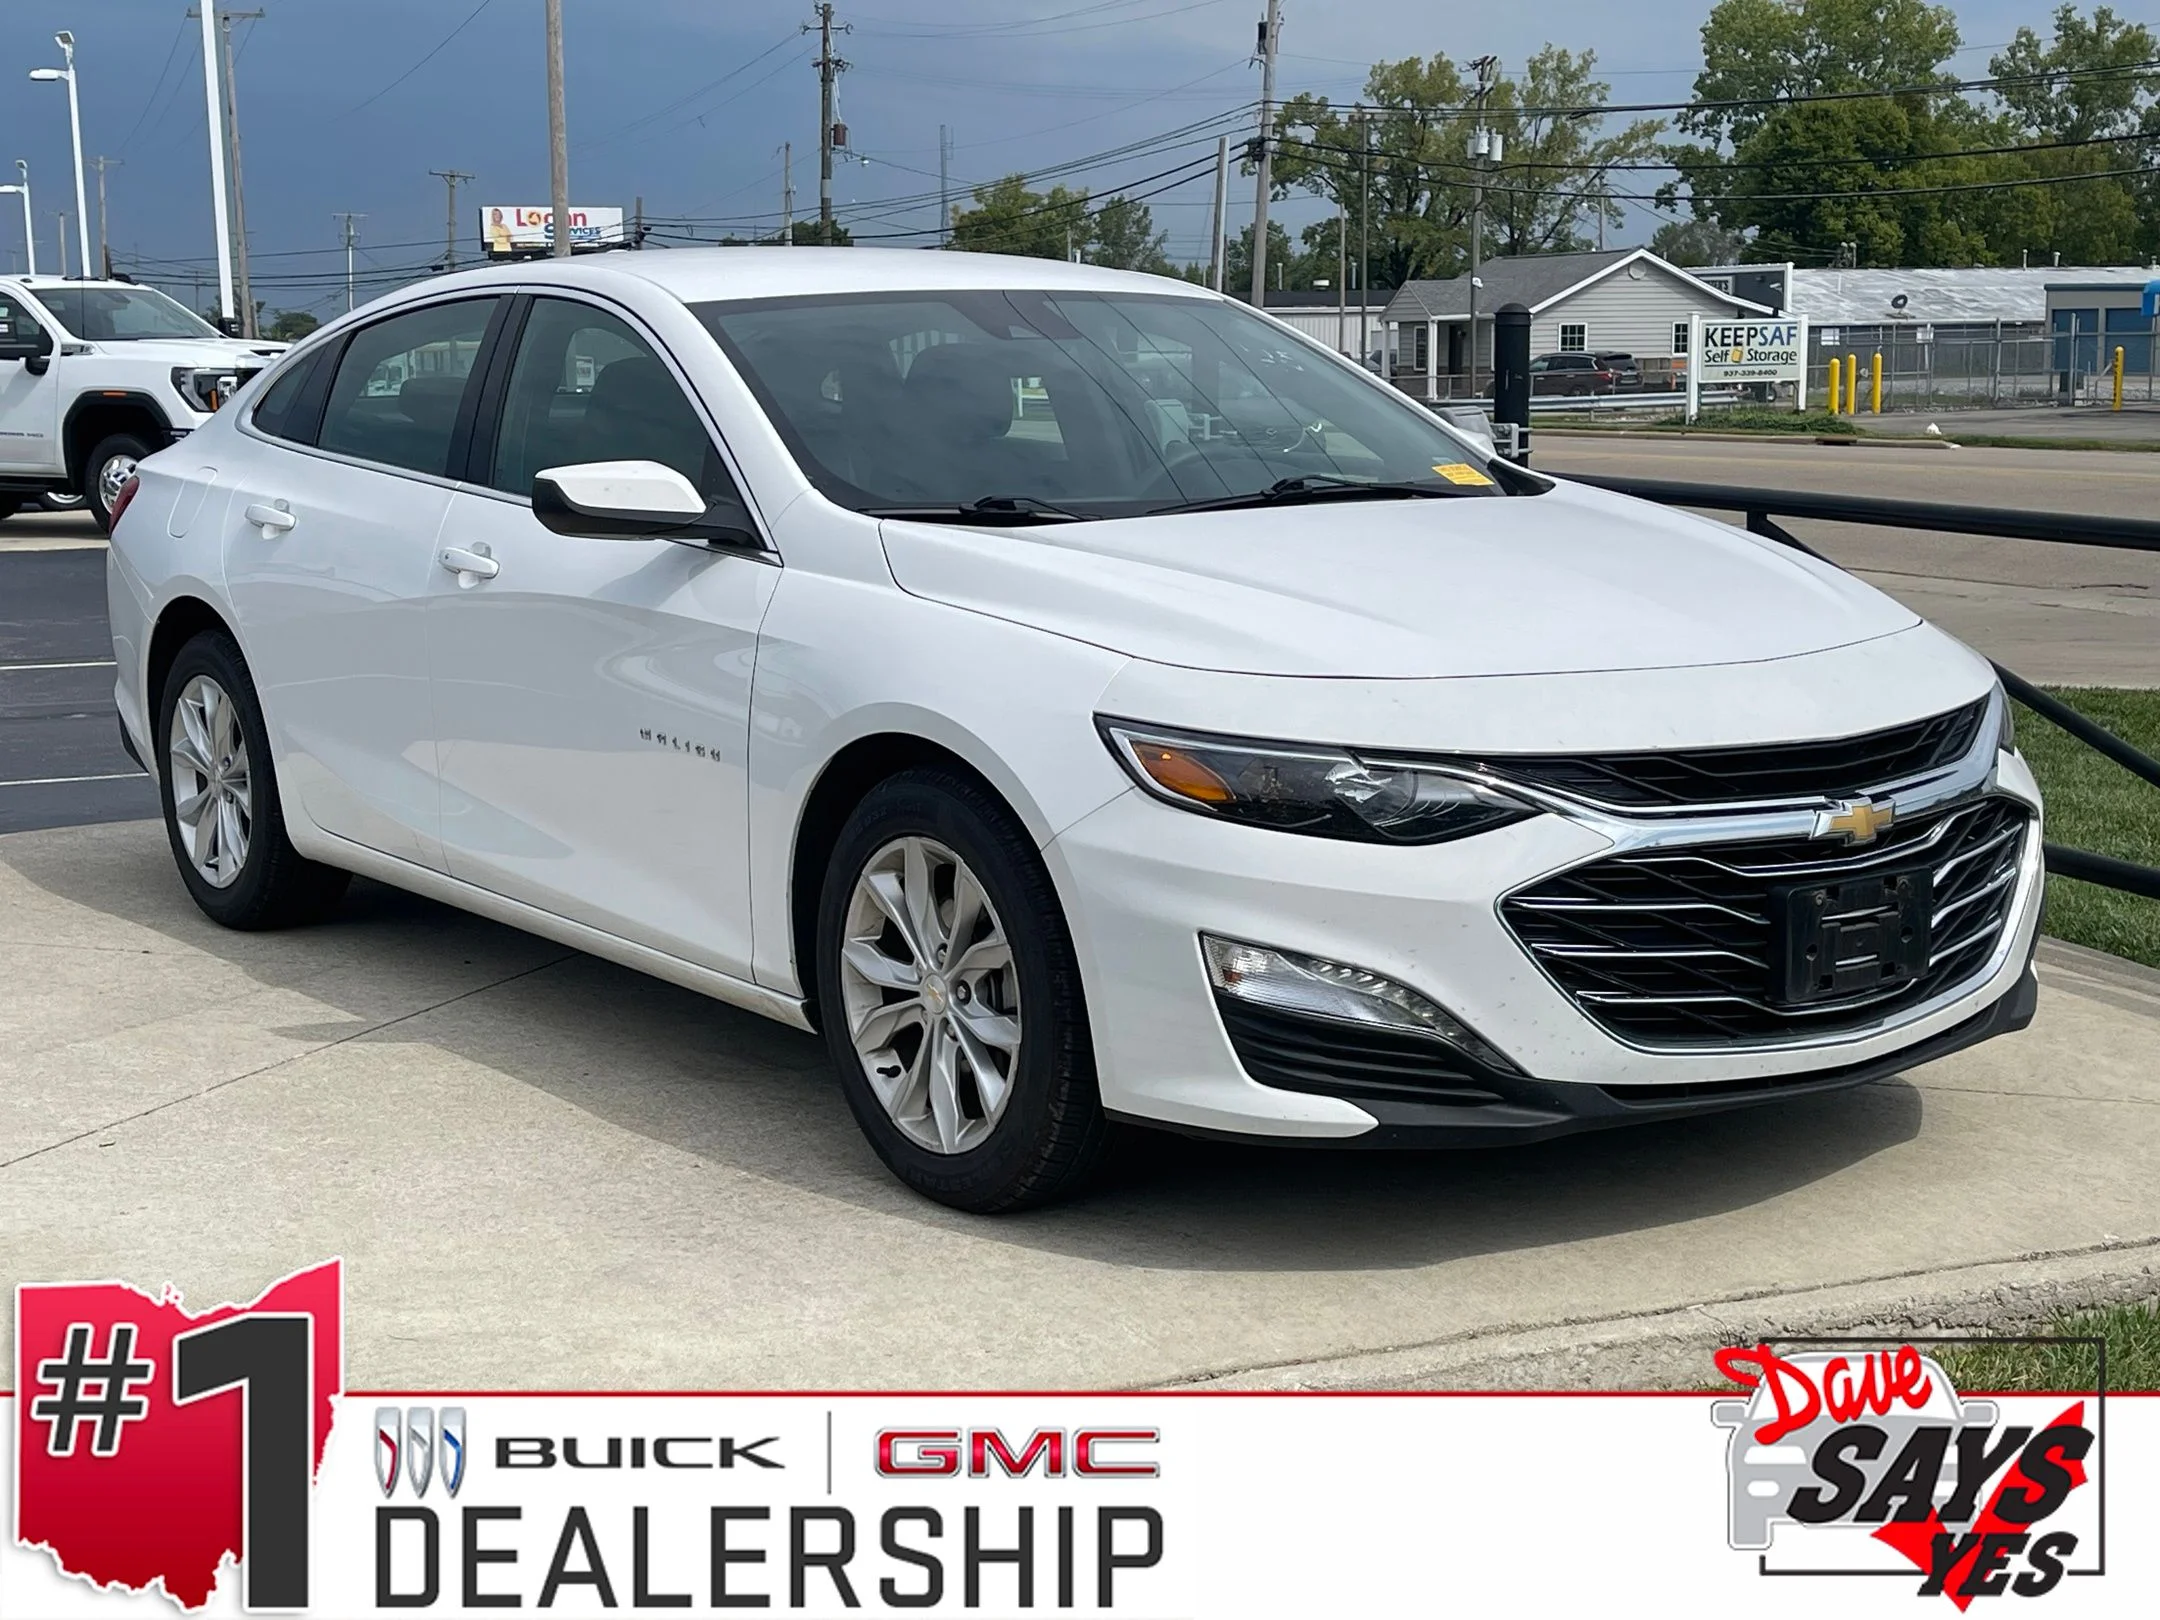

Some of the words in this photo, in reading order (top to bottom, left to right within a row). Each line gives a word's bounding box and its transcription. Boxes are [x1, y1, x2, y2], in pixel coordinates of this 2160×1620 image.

[1704, 326, 1798, 347] KEEPSAF
[1704, 349, 1730, 363] Self
[1746, 348, 1797, 365] Storage
